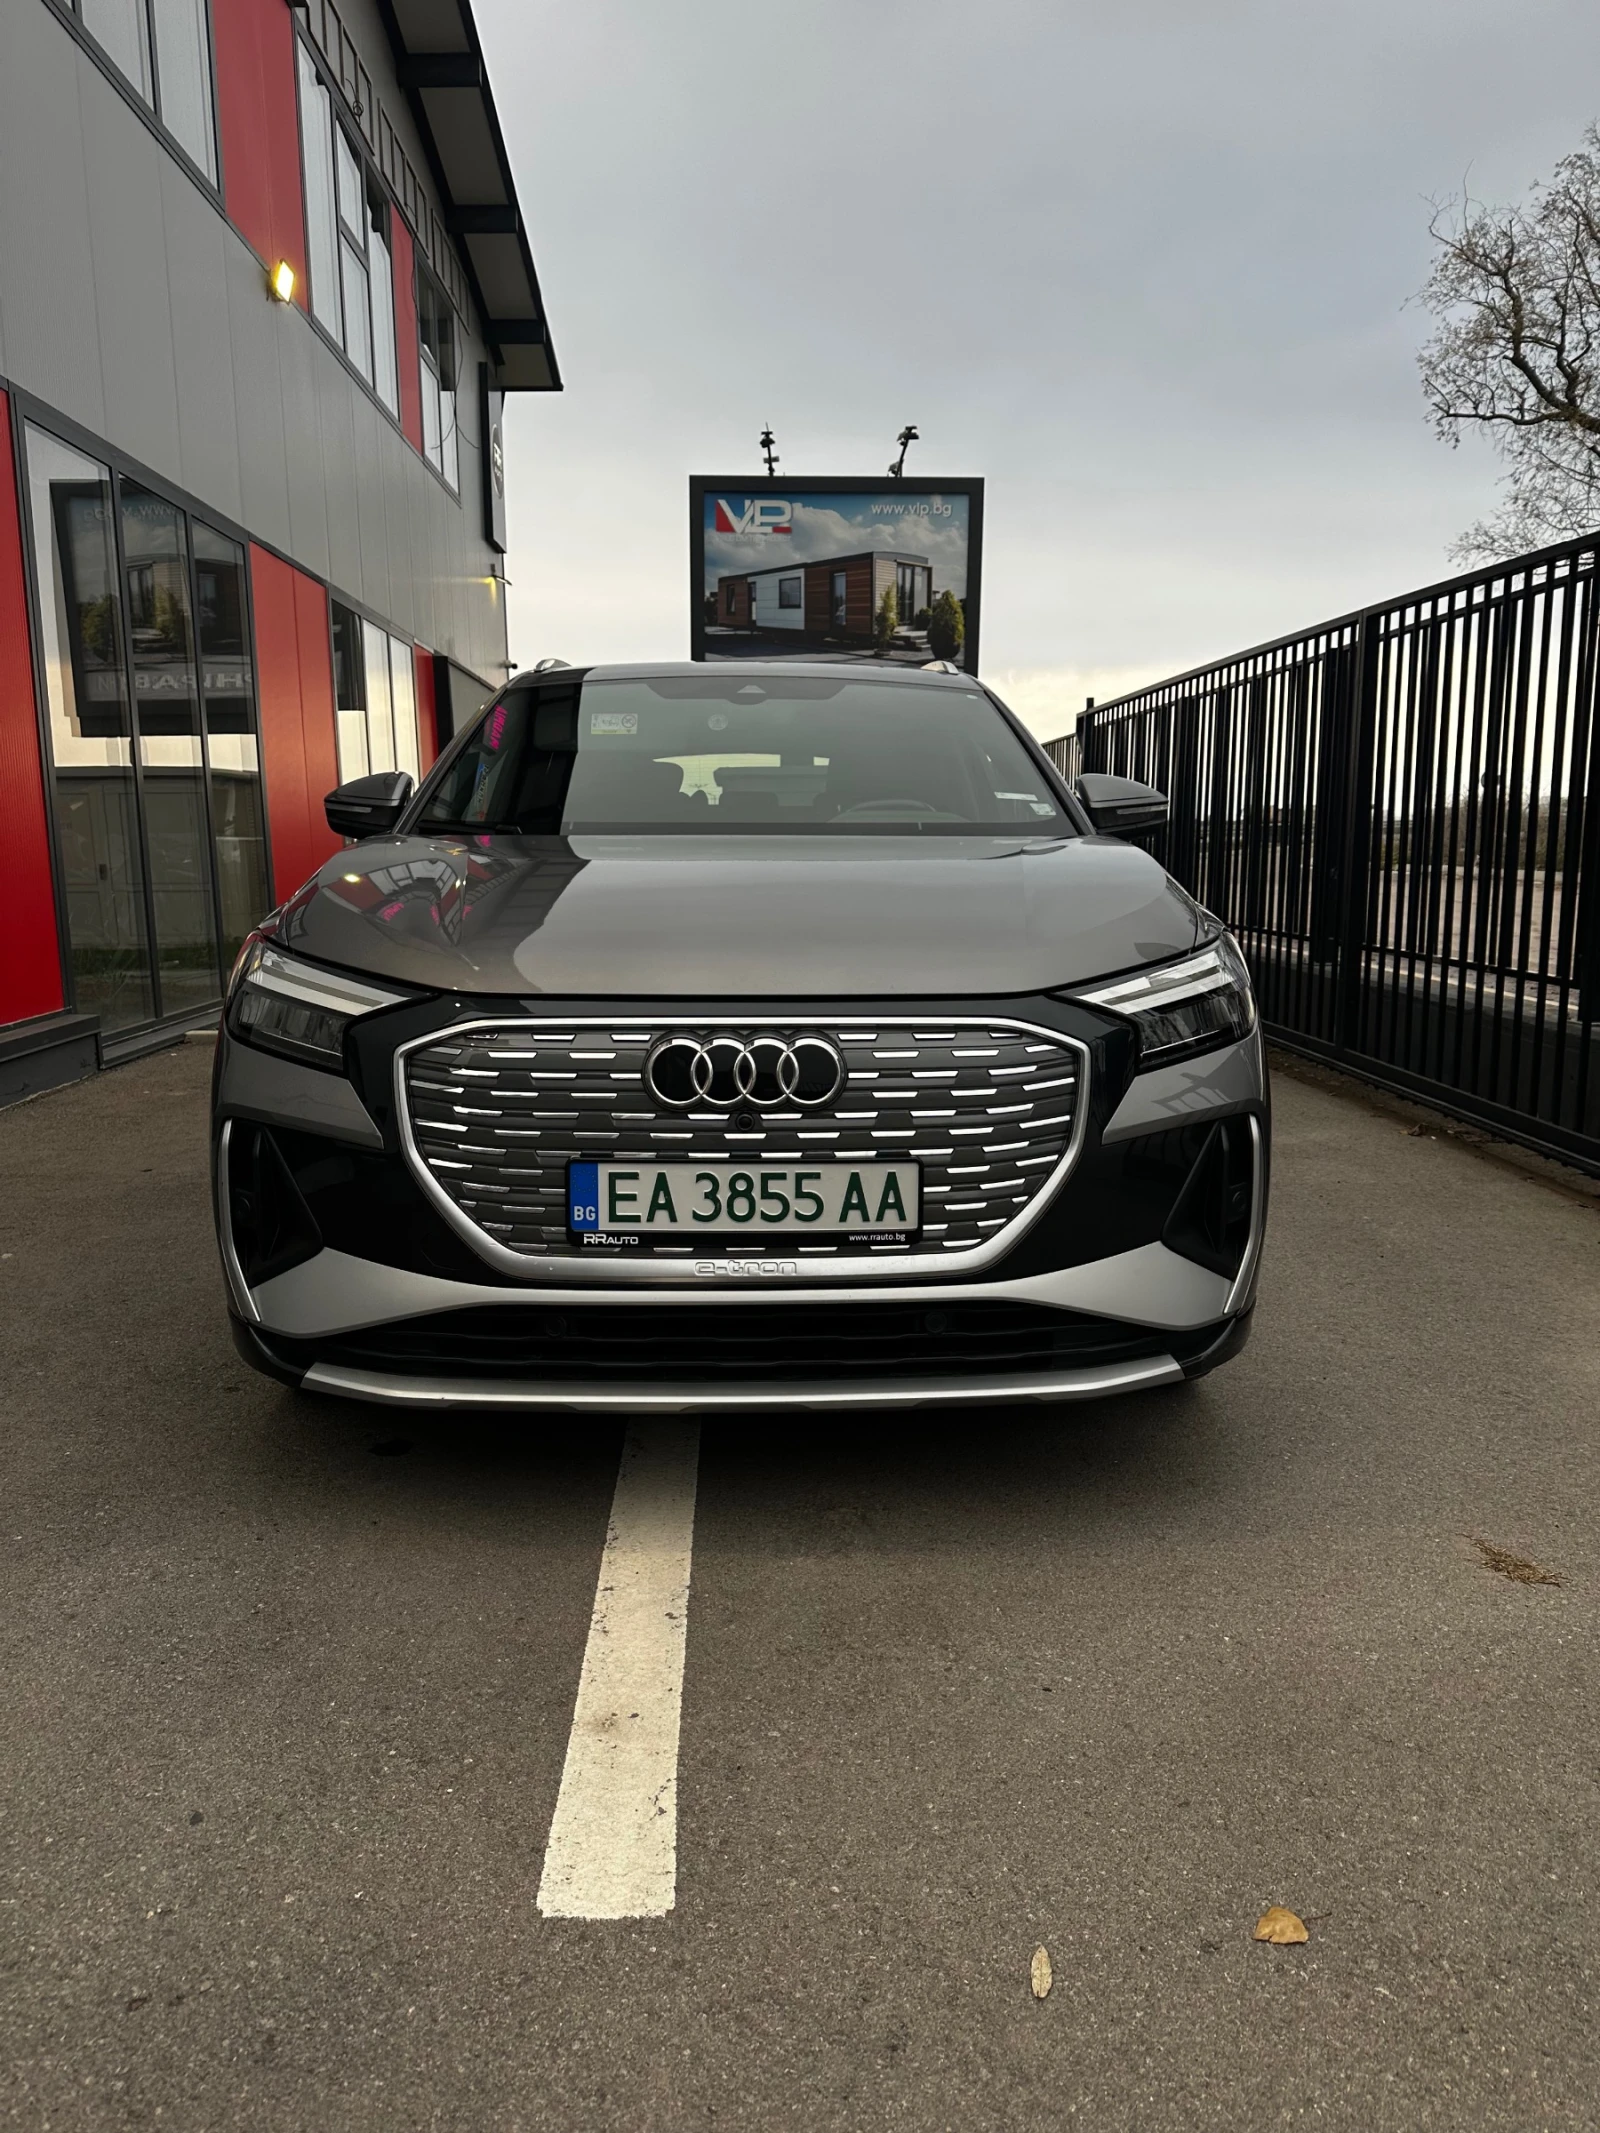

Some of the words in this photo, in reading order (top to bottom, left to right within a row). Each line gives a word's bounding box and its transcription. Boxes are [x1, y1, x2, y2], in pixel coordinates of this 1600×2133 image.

[871, 502, 952, 517] www.vlp.bg
[608, 1171, 678, 1223] EA
[692, 1171, 825, 1223] 3855
[838, 1171, 907, 1222] AA
[573, 1206, 596, 1221] BG
[848, 1233, 906, 1242] www.rrauto.bg
[694, 1260, 798, 1277] e-tron
